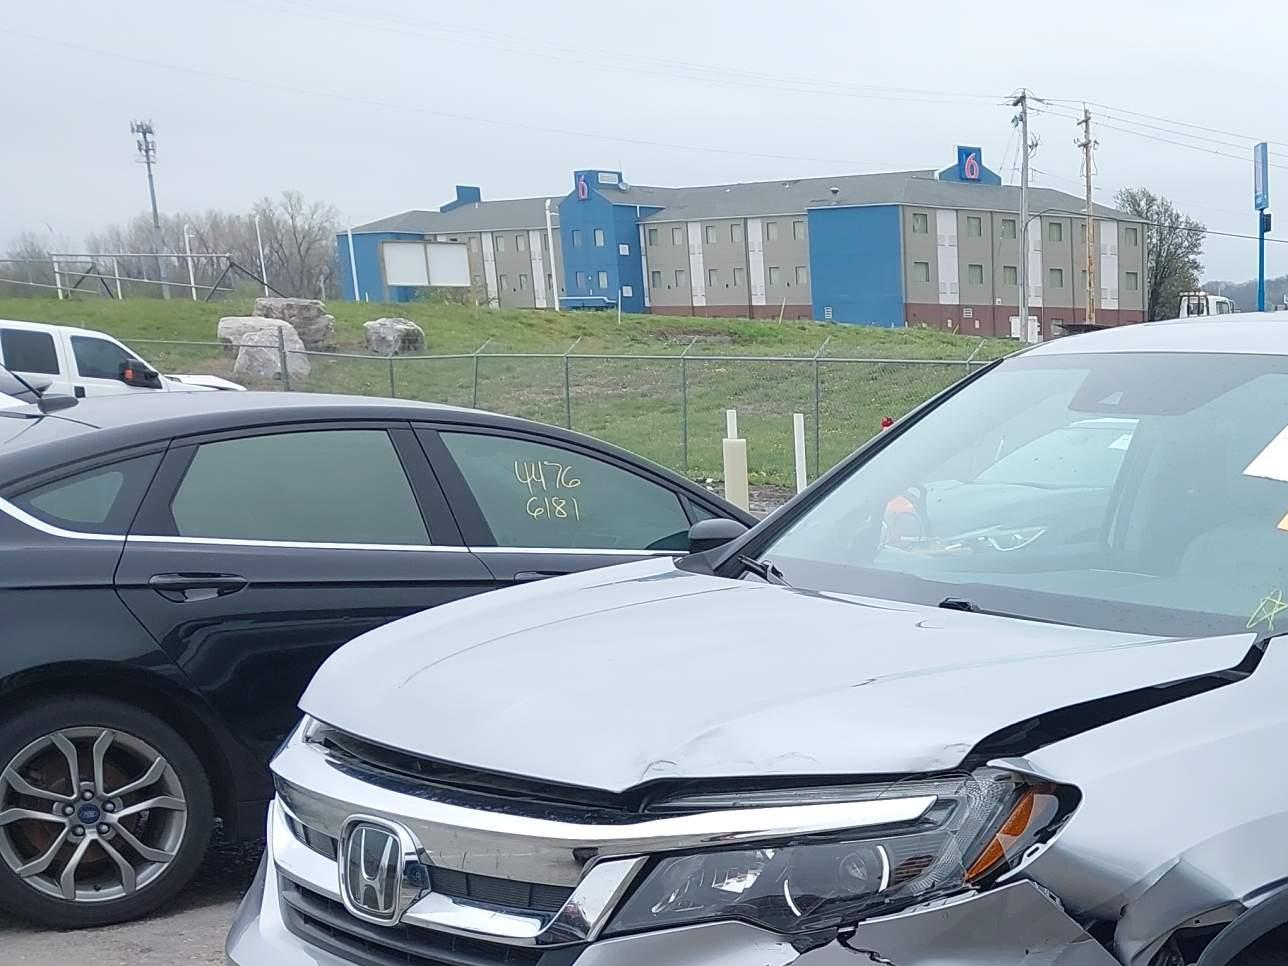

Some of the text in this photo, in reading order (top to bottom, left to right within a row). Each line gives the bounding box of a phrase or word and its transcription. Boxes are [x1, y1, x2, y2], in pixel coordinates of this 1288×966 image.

[964, 152, 980, 179] 6
[578, 173, 588, 200] 6
[513, 459, 582, 495] 4476
[526, 495, 581, 521] 6181
